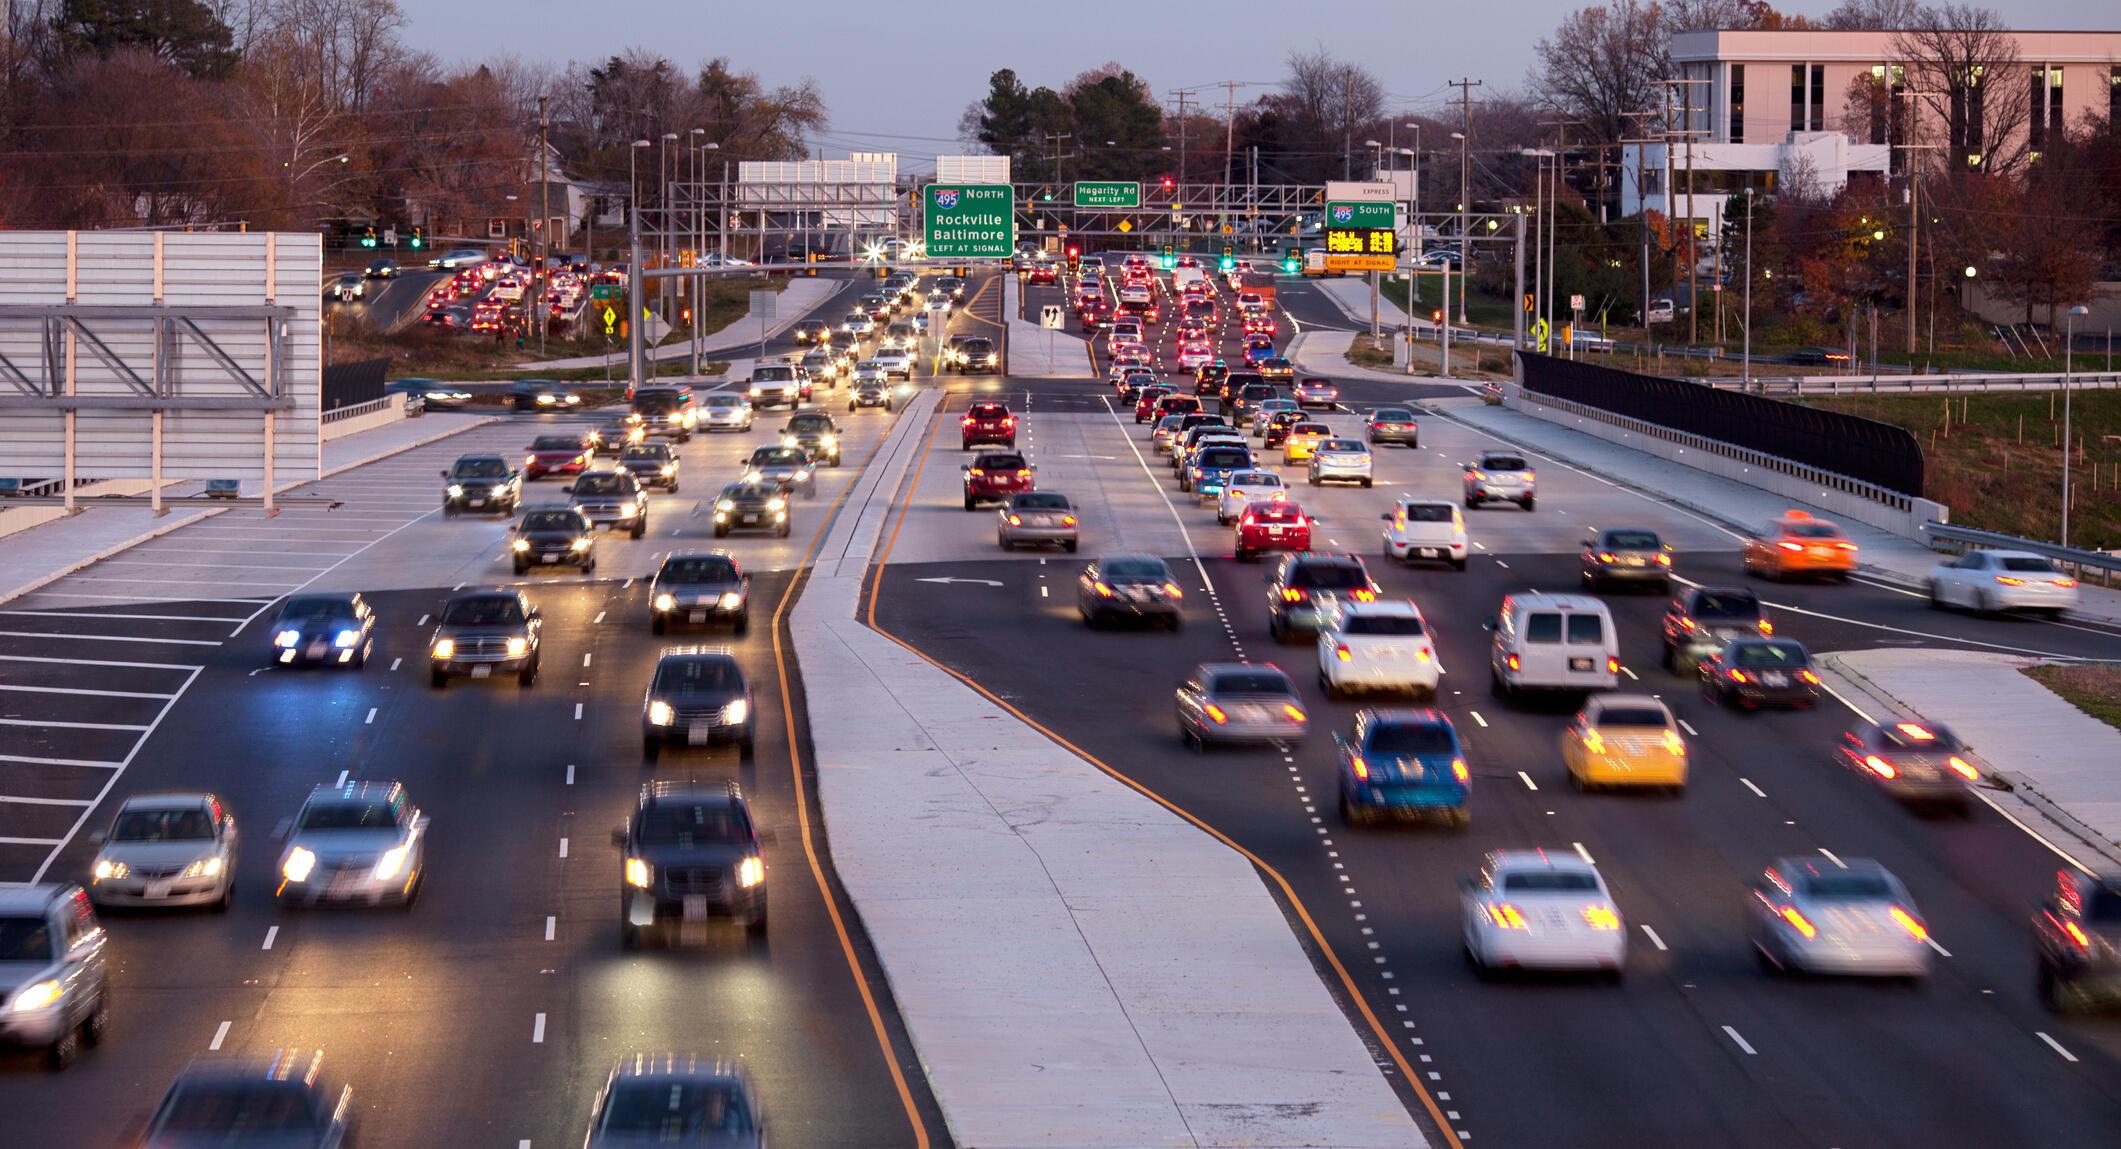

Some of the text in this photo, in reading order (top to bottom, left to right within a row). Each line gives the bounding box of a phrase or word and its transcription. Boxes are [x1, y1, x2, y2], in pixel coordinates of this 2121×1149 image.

[966, 189, 1004, 199] NORTH
[937, 194, 957, 206] 495
[1334, 210, 1352, 220] 495
[1359, 206, 1390, 214] SOUTH
[936, 214, 1002, 225] Rockville
[934, 229, 1005, 240] Baltimore
